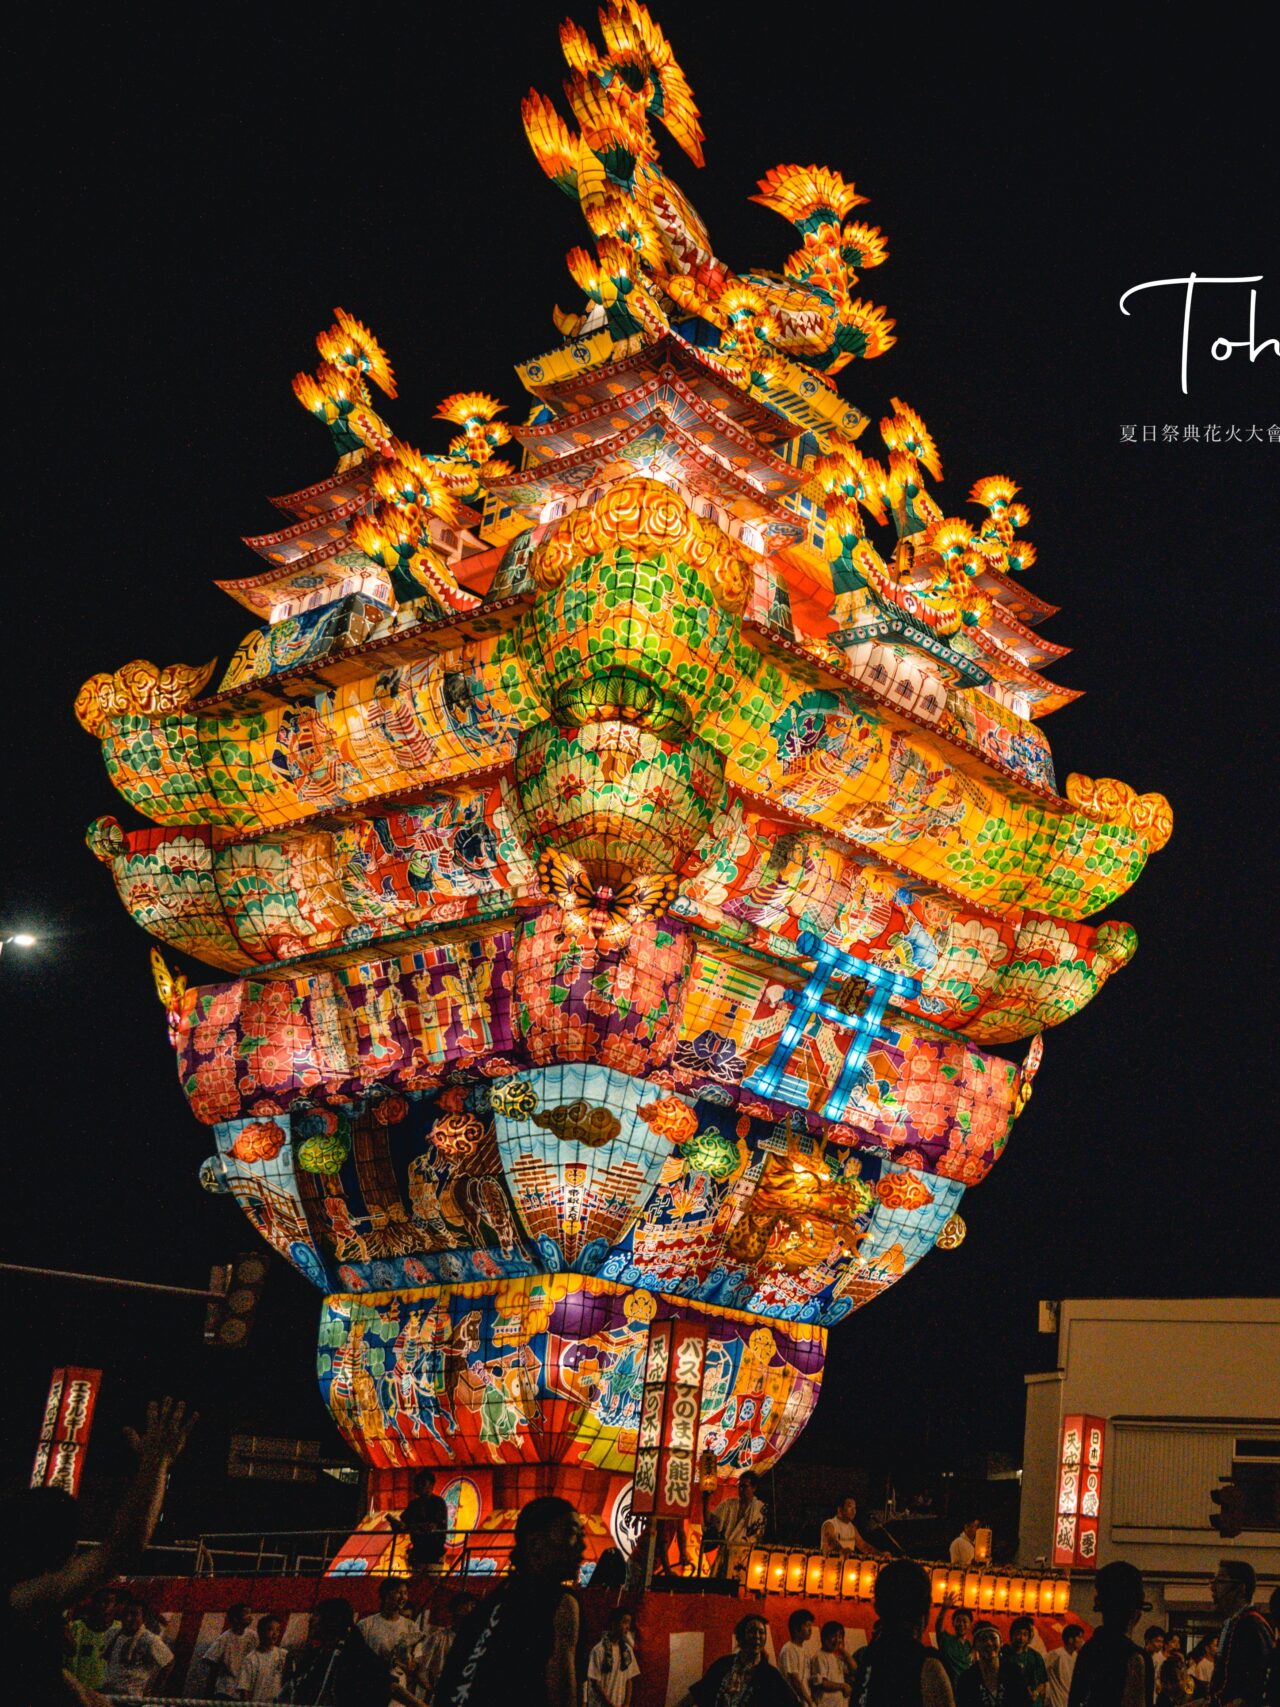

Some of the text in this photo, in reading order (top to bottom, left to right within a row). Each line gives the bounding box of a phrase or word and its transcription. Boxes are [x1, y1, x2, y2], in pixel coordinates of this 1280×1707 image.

[667, 1338, 702, 1503] バスケのまち能代
